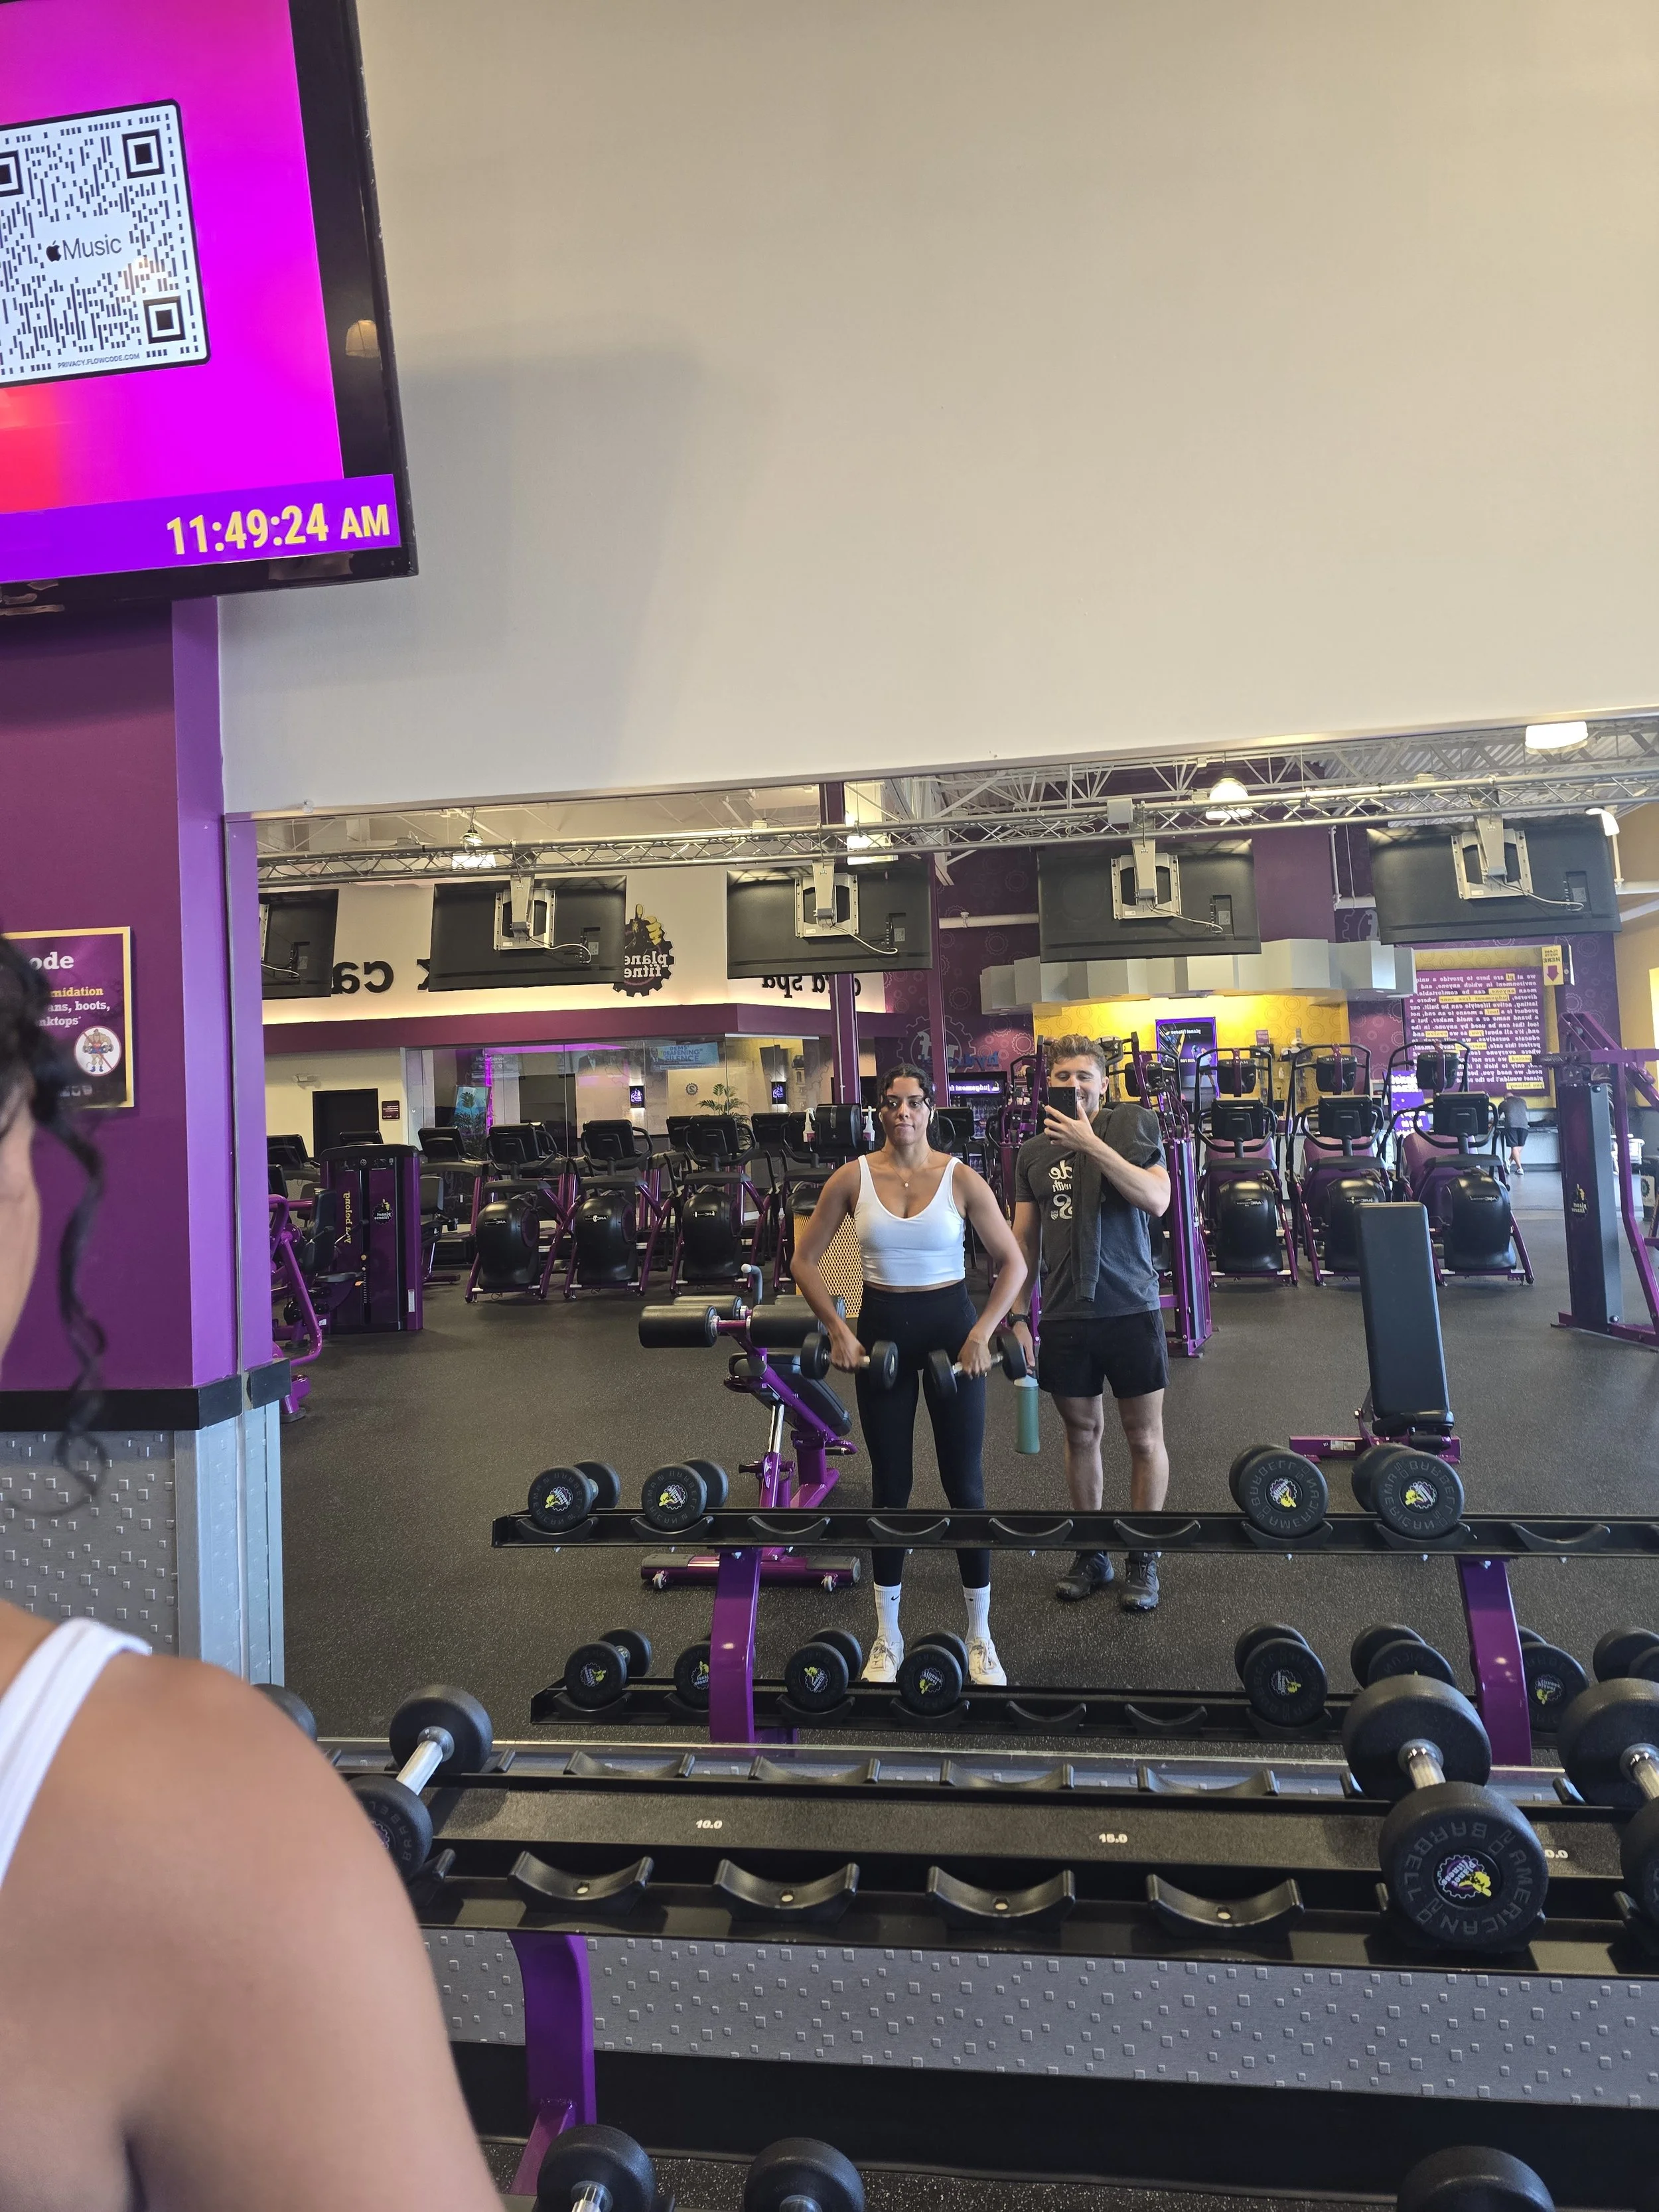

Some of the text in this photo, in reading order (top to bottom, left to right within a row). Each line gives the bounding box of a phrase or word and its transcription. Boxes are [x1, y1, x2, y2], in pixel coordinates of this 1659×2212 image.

[62, 234, 122, 260] Music
[58, 353, 140, 368] PRIVACY.FLOWCODE.COM
[167, 502, 390, 555] 11:49:24 AM
[30, 952, 74, 970] ode
[48, 1001, 110, 1013] ans, boots,
[369, 1801, 412, 1862] BARBEL
[695, 1819, 723, 1829] 10.0
[1405, 1822, 1488, 1901] BARBELL
[1544, 1849, 1568, 1859] 0.0
[1440, 1850, 1534, 1936] AMERICAN
